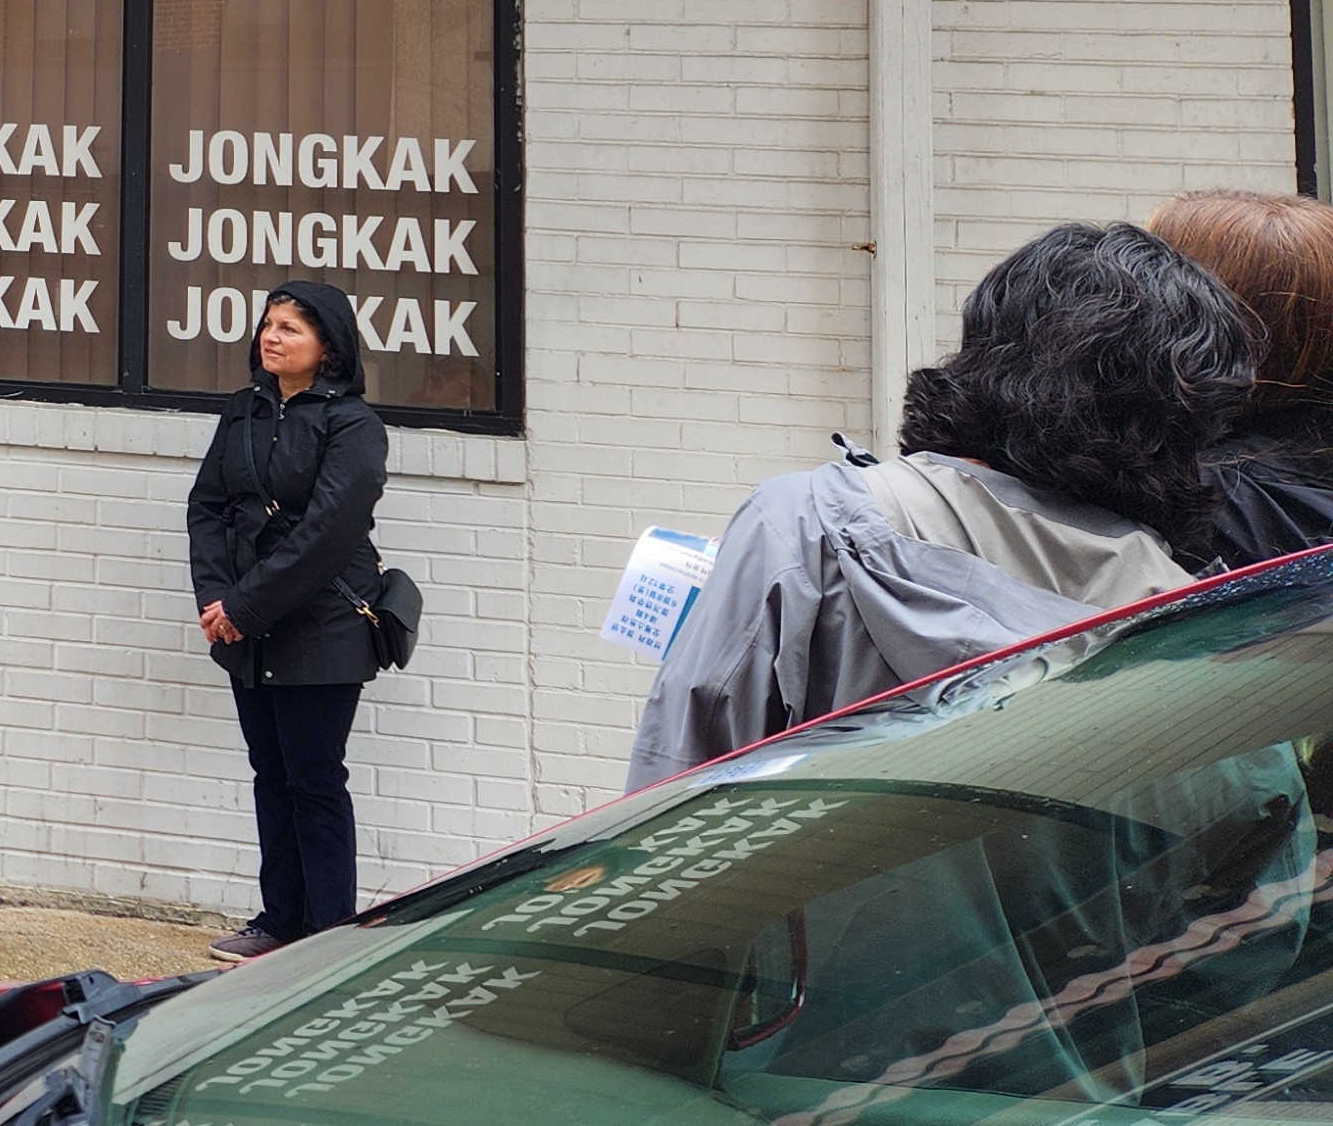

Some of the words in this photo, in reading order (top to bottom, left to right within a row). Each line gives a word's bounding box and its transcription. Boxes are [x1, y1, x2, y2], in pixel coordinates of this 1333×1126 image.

[169, 129, 480, 195] JONGKAK
[168, 207, 480, 276] JONGKAK
[166, 285, 481, 358] JOKAK
